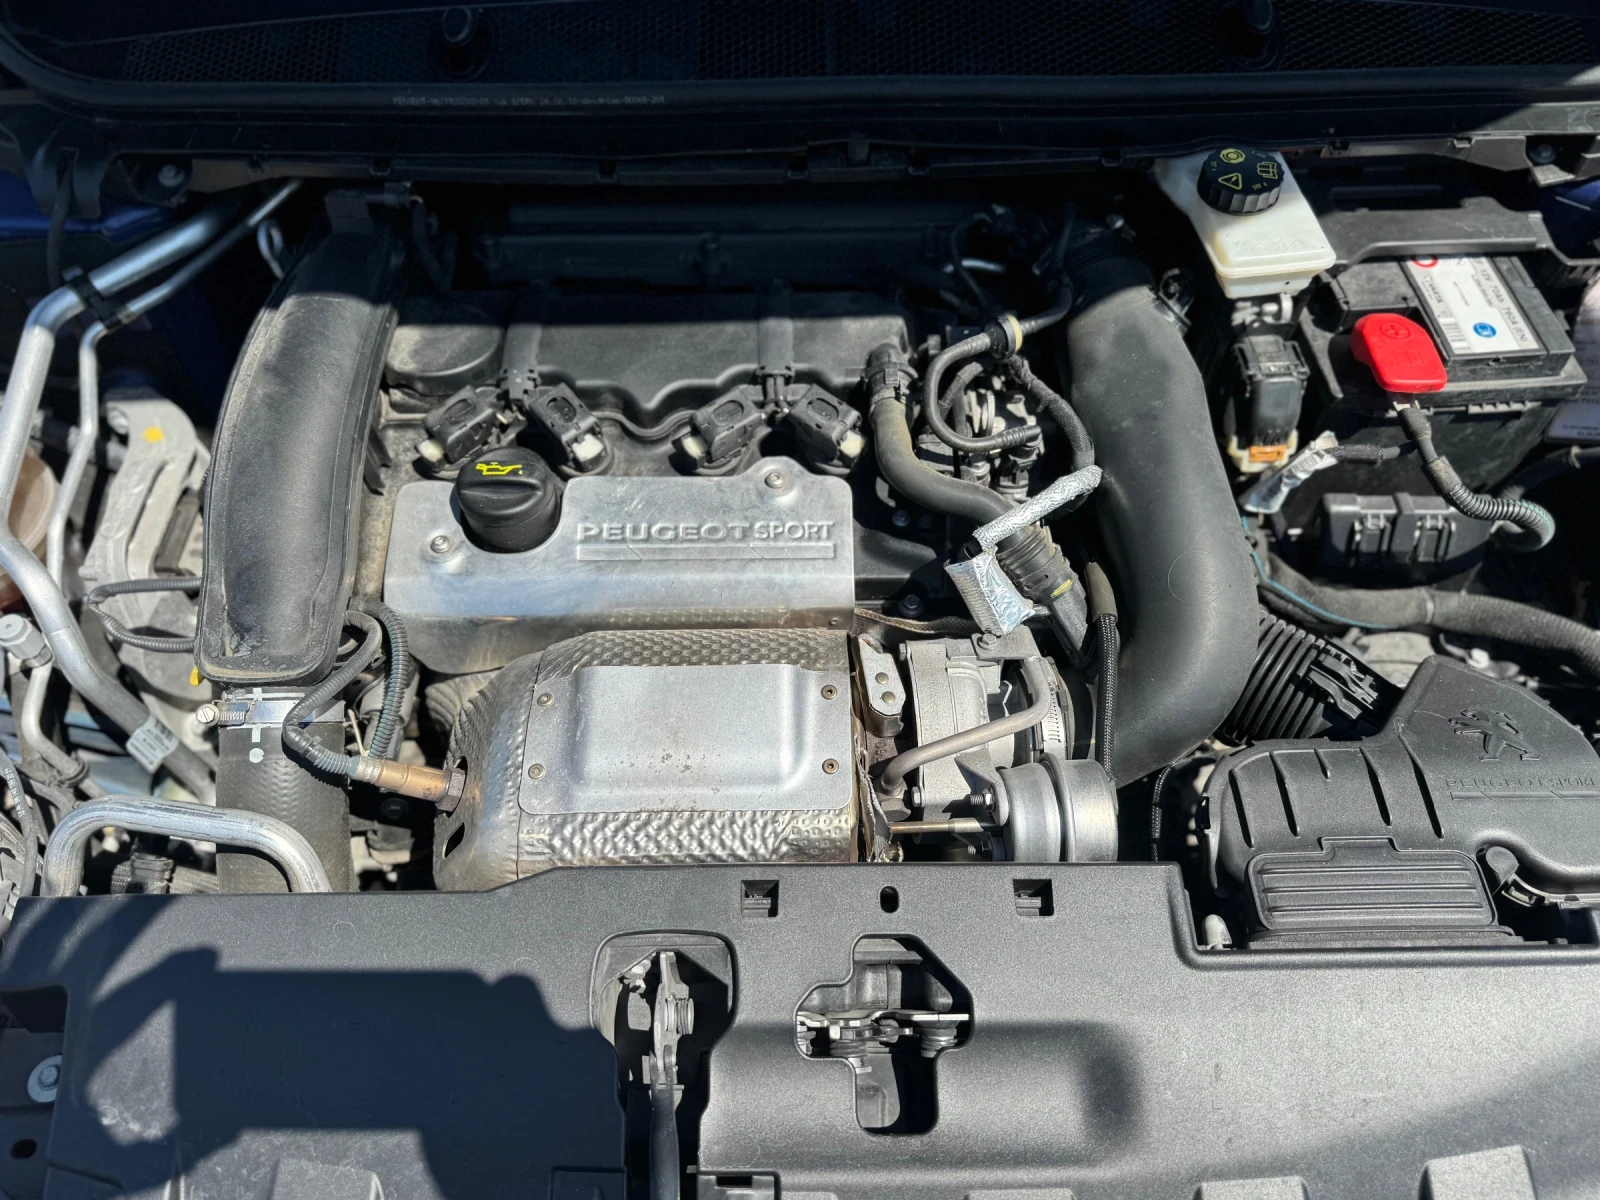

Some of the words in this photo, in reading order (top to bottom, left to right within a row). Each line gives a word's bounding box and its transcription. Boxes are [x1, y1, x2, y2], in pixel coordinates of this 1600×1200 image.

[577, 522, 750, 541] PEUGEOT
[754, 520, 834, 539] SPORT
[1444, 778, 1543, 788] PEUGEOT
